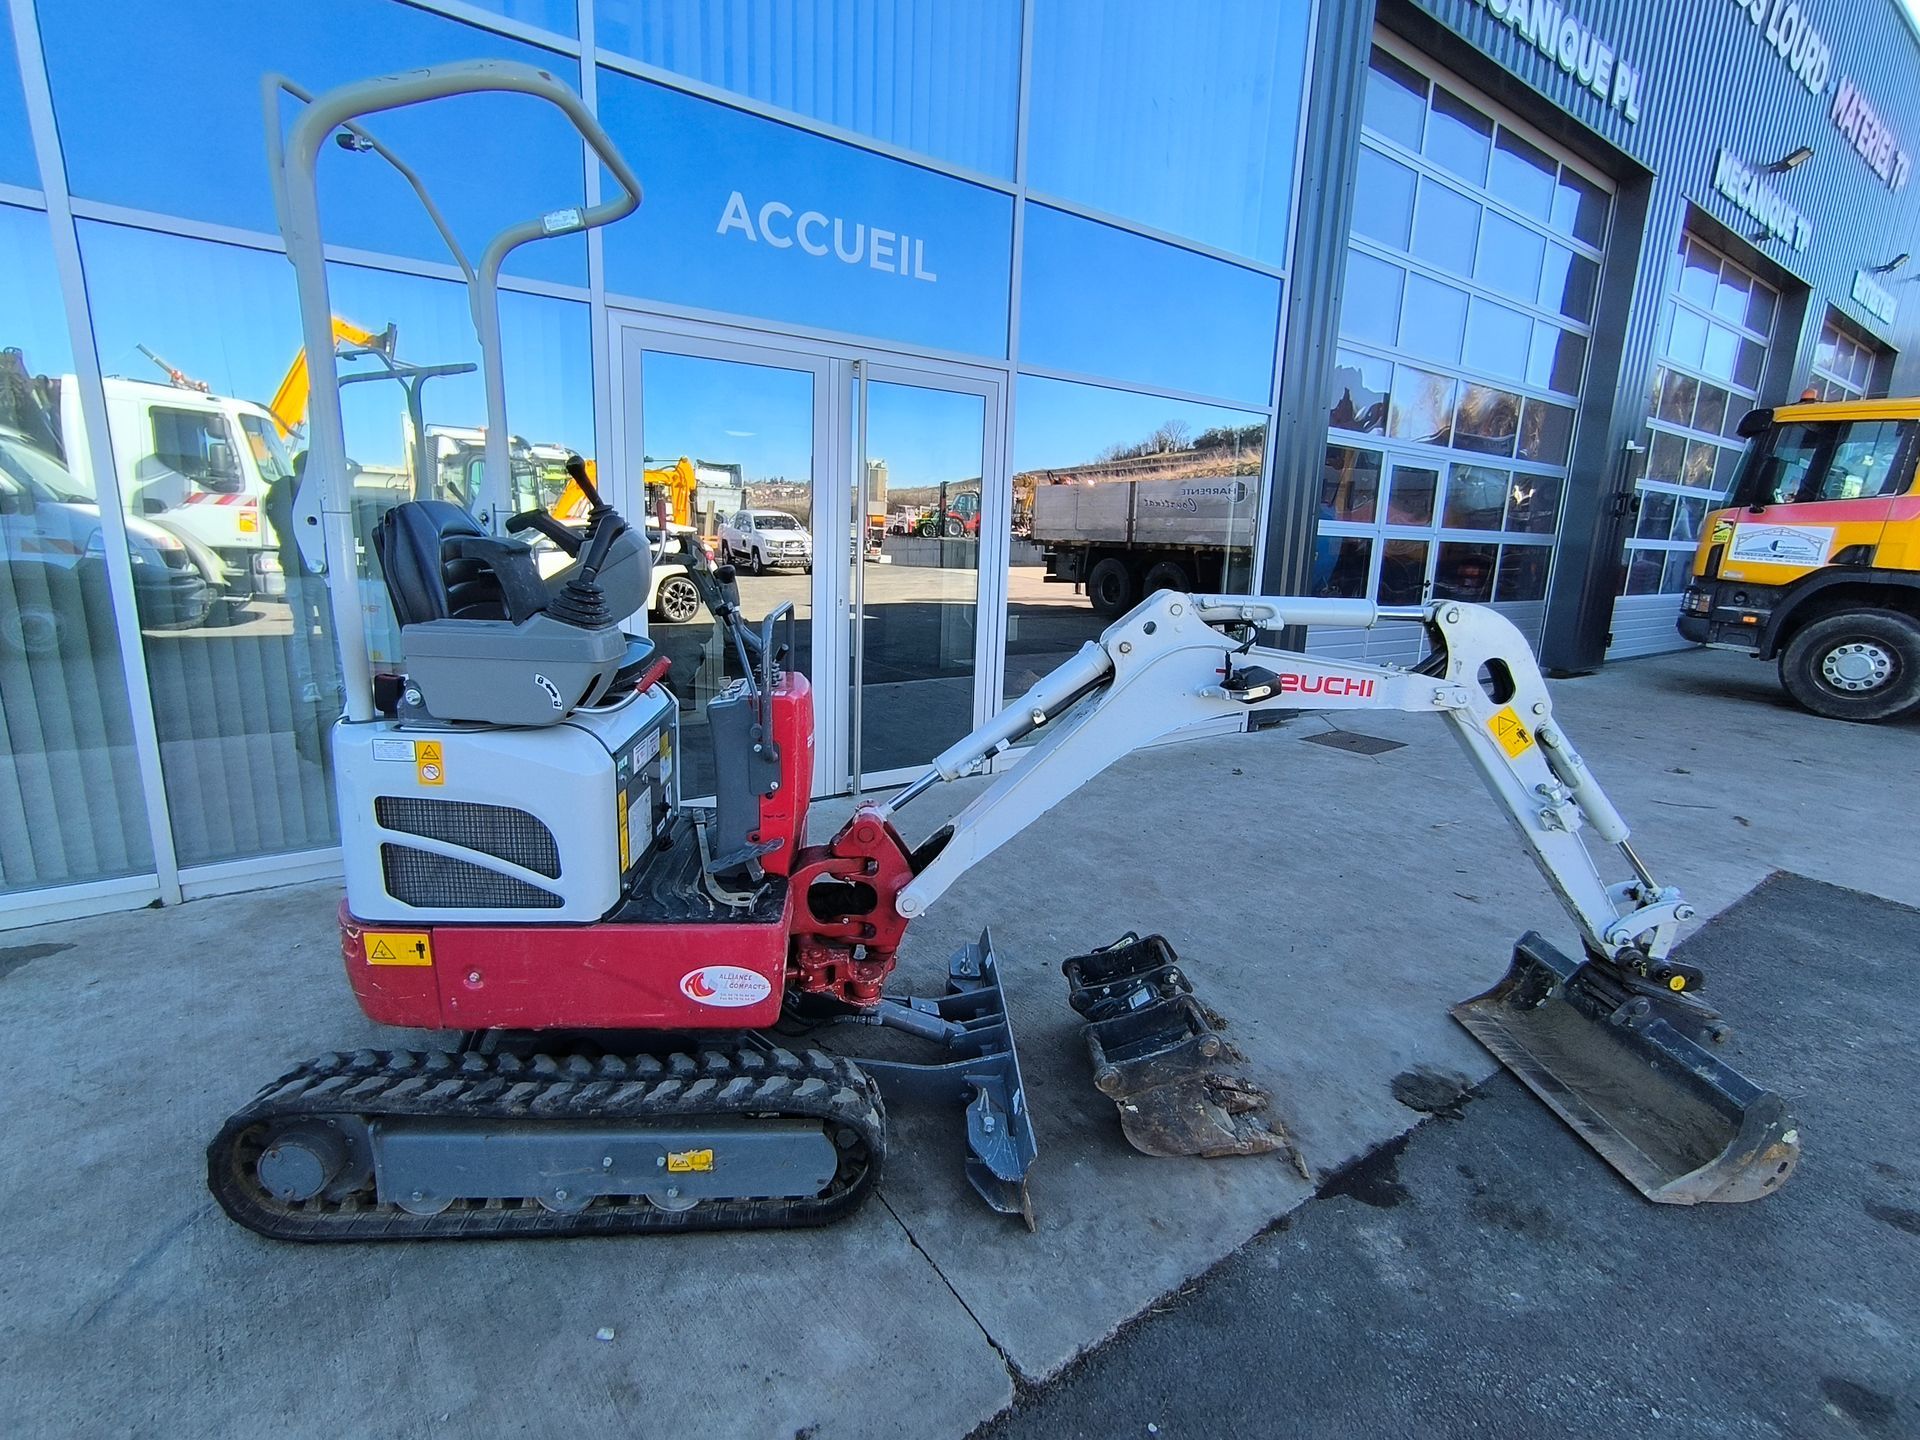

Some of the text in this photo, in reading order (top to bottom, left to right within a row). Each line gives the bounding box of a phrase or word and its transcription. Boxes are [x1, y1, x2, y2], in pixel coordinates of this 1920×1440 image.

[1473, 0, 1642, 124] ANIQUE PL
[1830, 74, 1897, 182] MATERIEL
[716, 190, 937, 282] ACCUEIL
[1713, 147, 1799, 247] MECANIQUE
